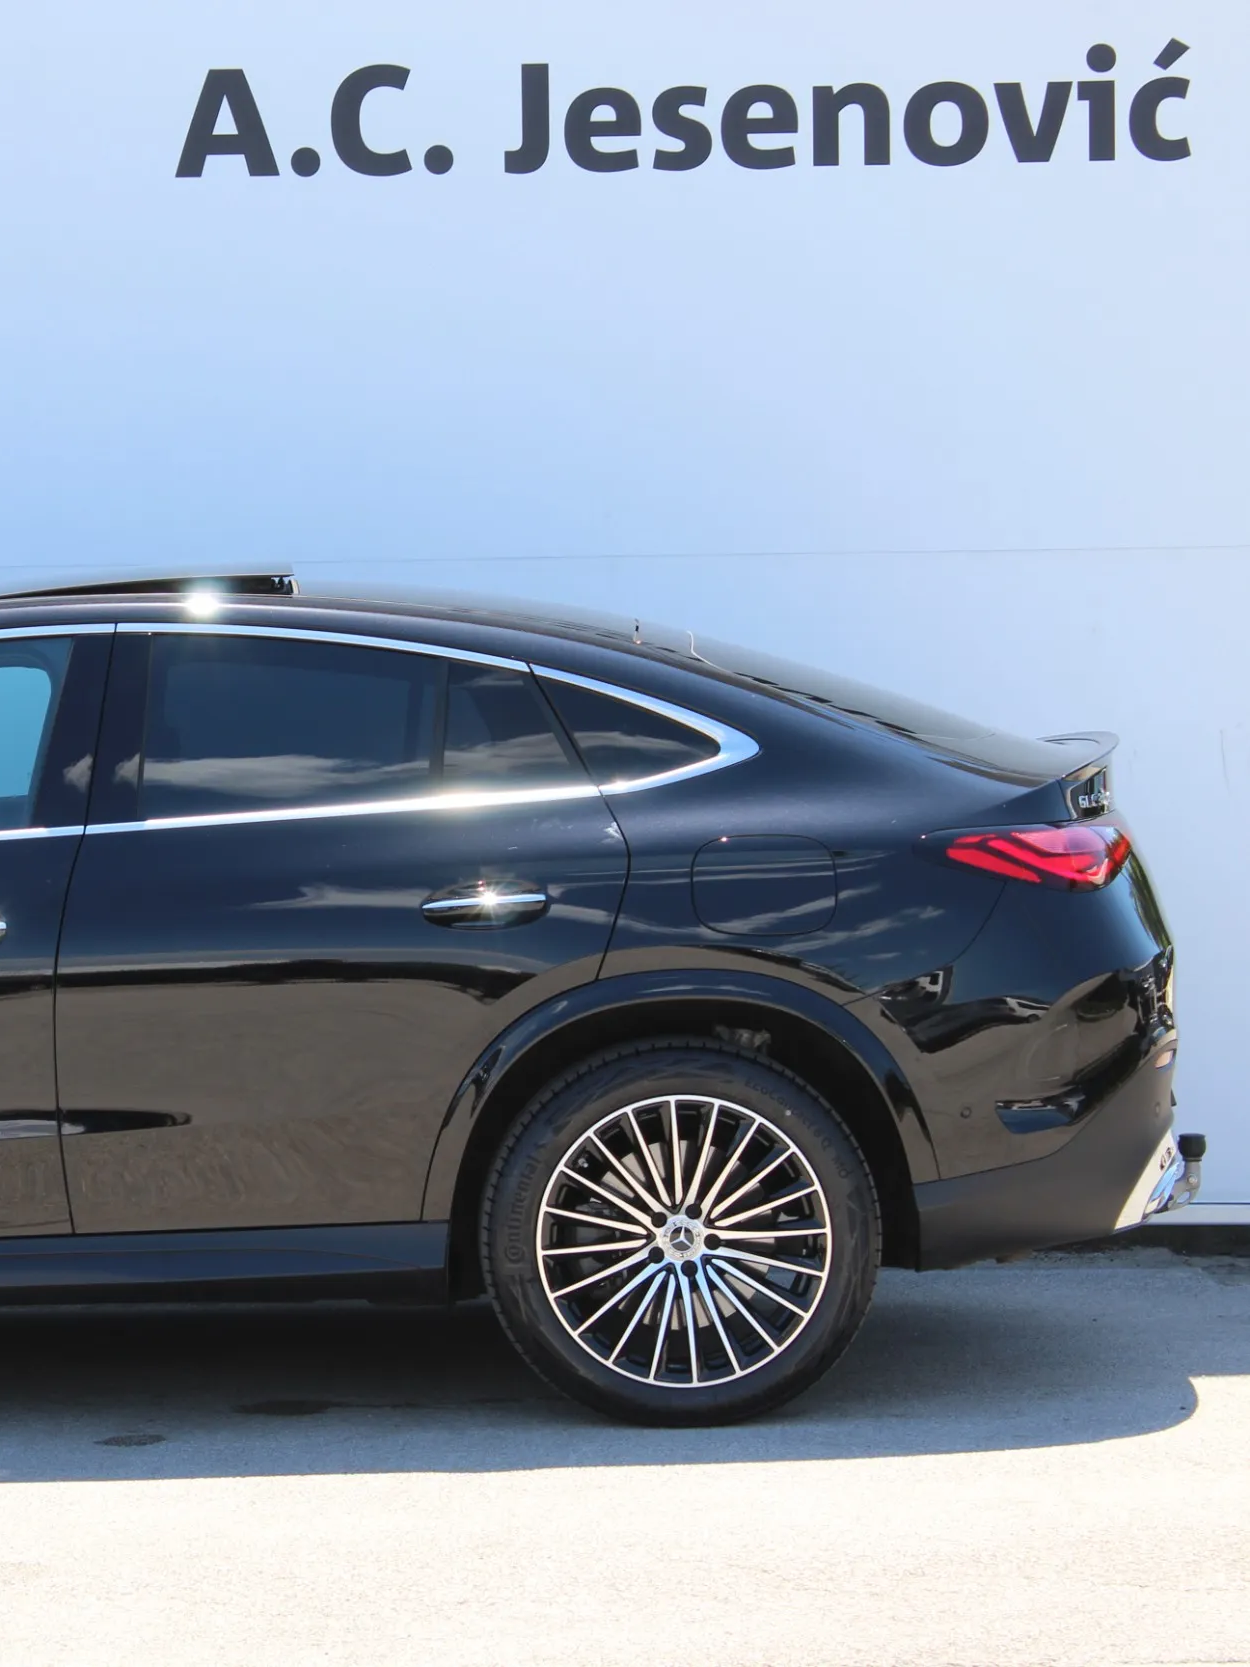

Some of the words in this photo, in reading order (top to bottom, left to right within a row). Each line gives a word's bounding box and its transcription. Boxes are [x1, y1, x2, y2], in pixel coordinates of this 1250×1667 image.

[174, 63, 454, 179] A.C.
[503, 37, 1192, 175] Jesenović
[504, 1155, 542, 1264] Continental
